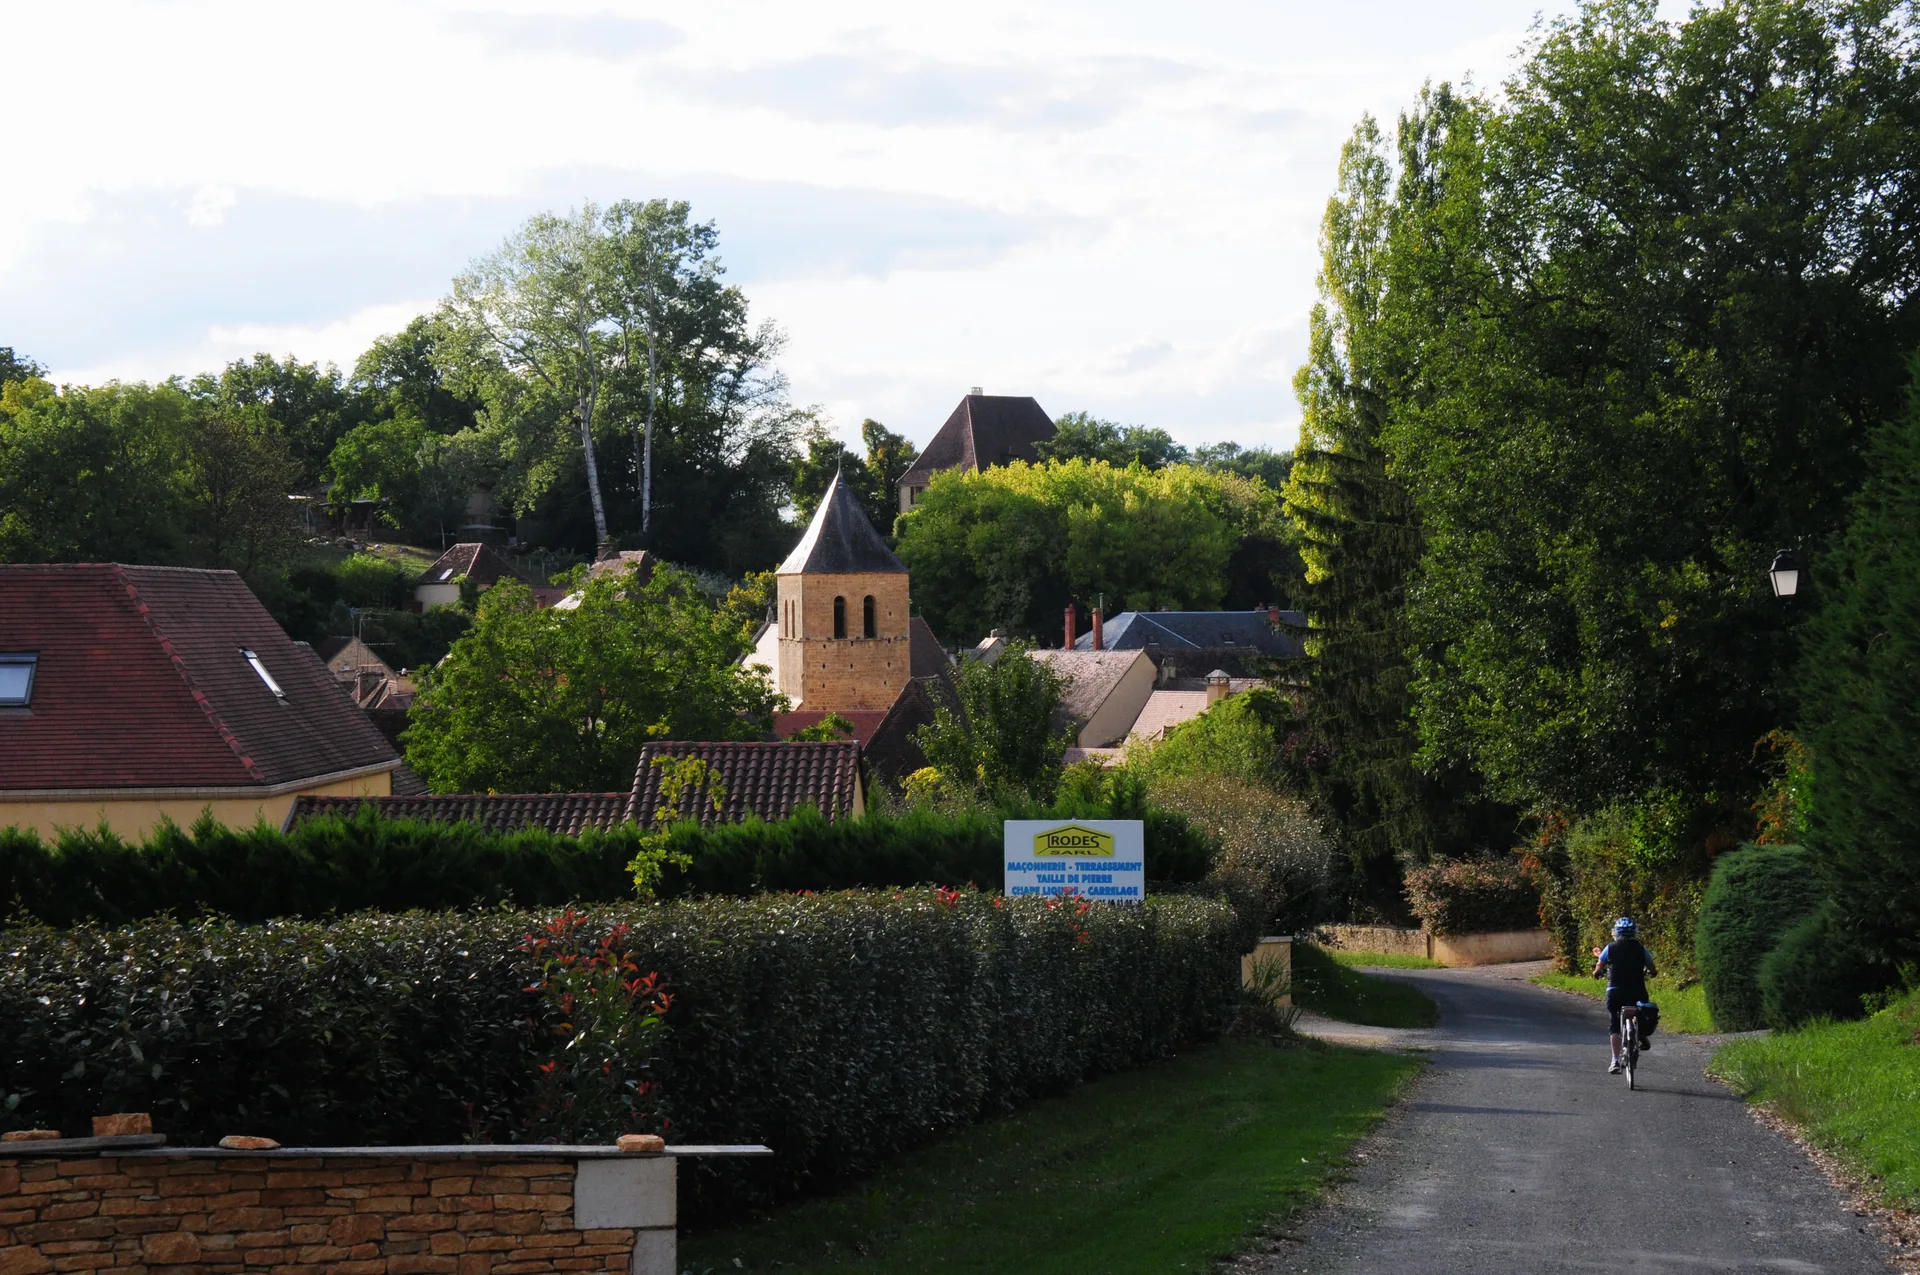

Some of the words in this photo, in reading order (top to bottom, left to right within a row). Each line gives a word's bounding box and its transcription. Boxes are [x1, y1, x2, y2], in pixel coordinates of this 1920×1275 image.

[1051, 836, 1100, 847] RODES
[1007, 862, 1066, 873] MAÇONNERIE
[1075, 862, 1142, 871] TERRASSEMENT
[1036, 874, 1065, 883] TAILLE
[1067, 874, 1079, 883] DE
[1081, 874, 1112, 883] PIERRE
[1088, 886, 1138, 896] CARRELAGE
